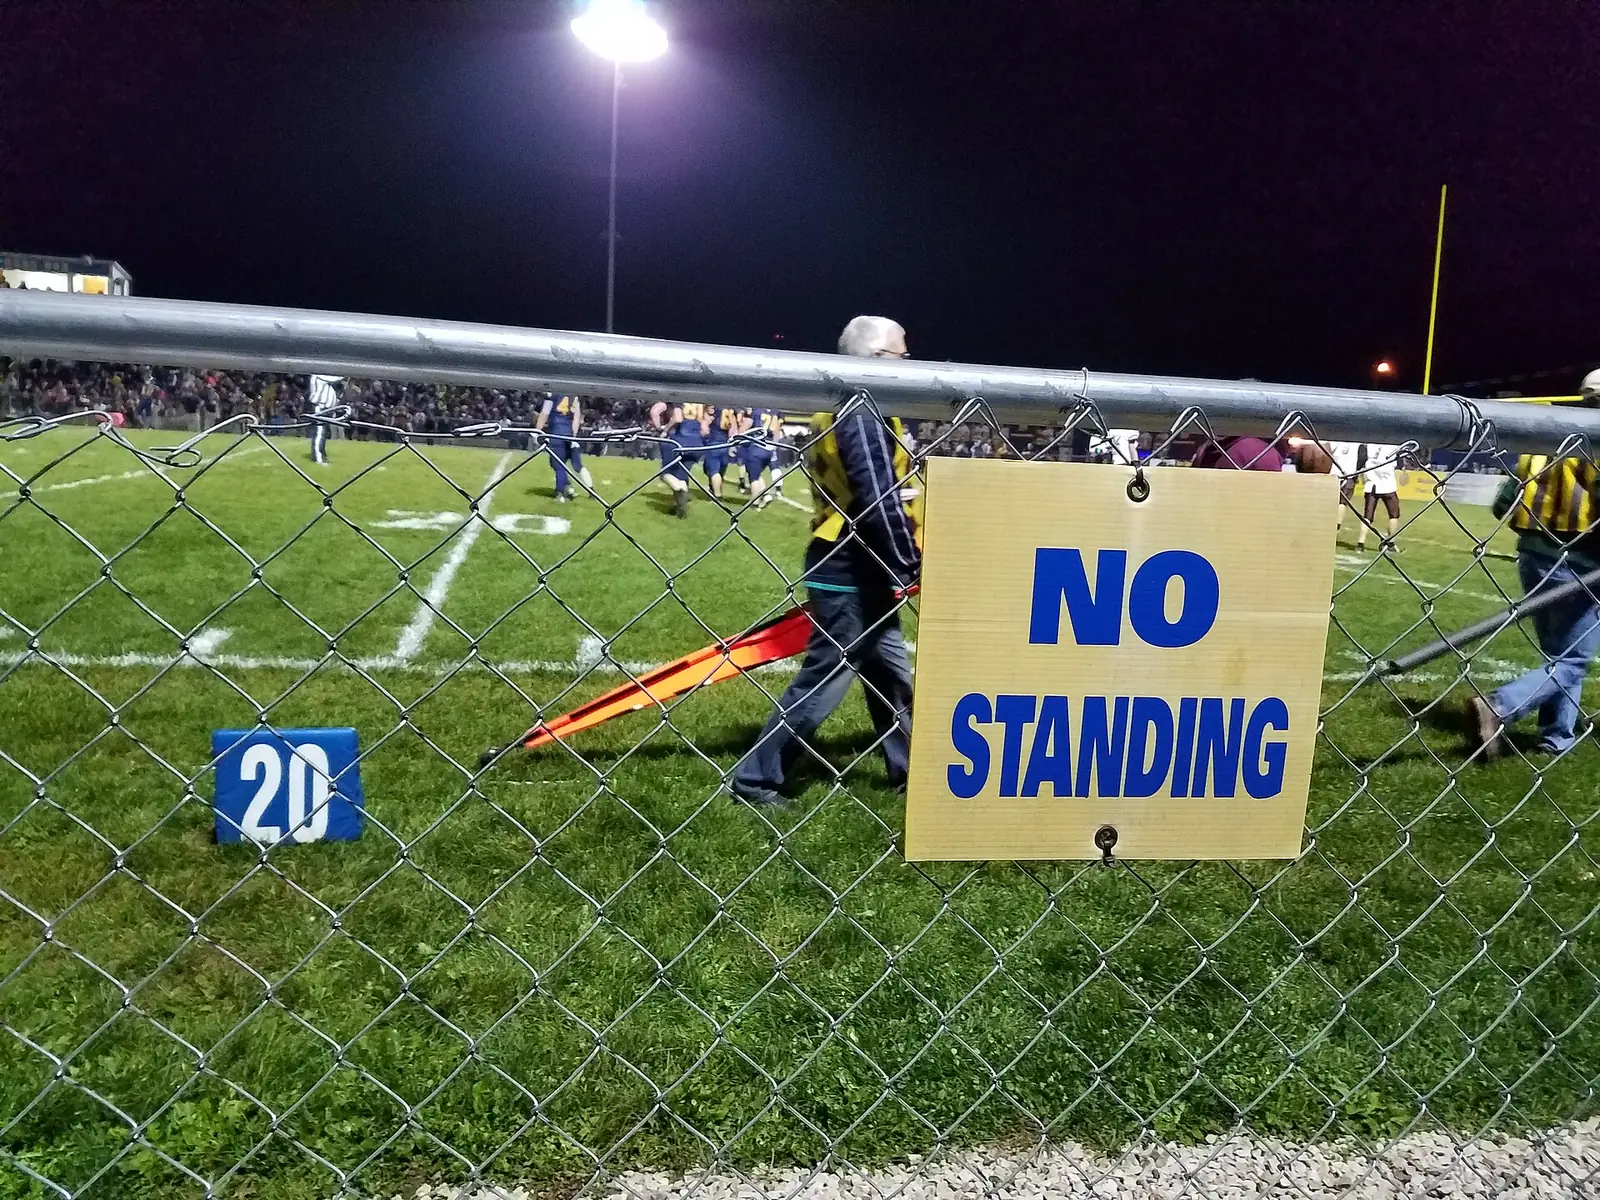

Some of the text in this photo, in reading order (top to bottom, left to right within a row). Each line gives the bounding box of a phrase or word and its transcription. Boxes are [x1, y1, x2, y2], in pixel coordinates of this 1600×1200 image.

[1028, 547, 1220, 648] NO
[240, 743, 329, 844] 20
[946, 692, 1289, 799] STANDING
